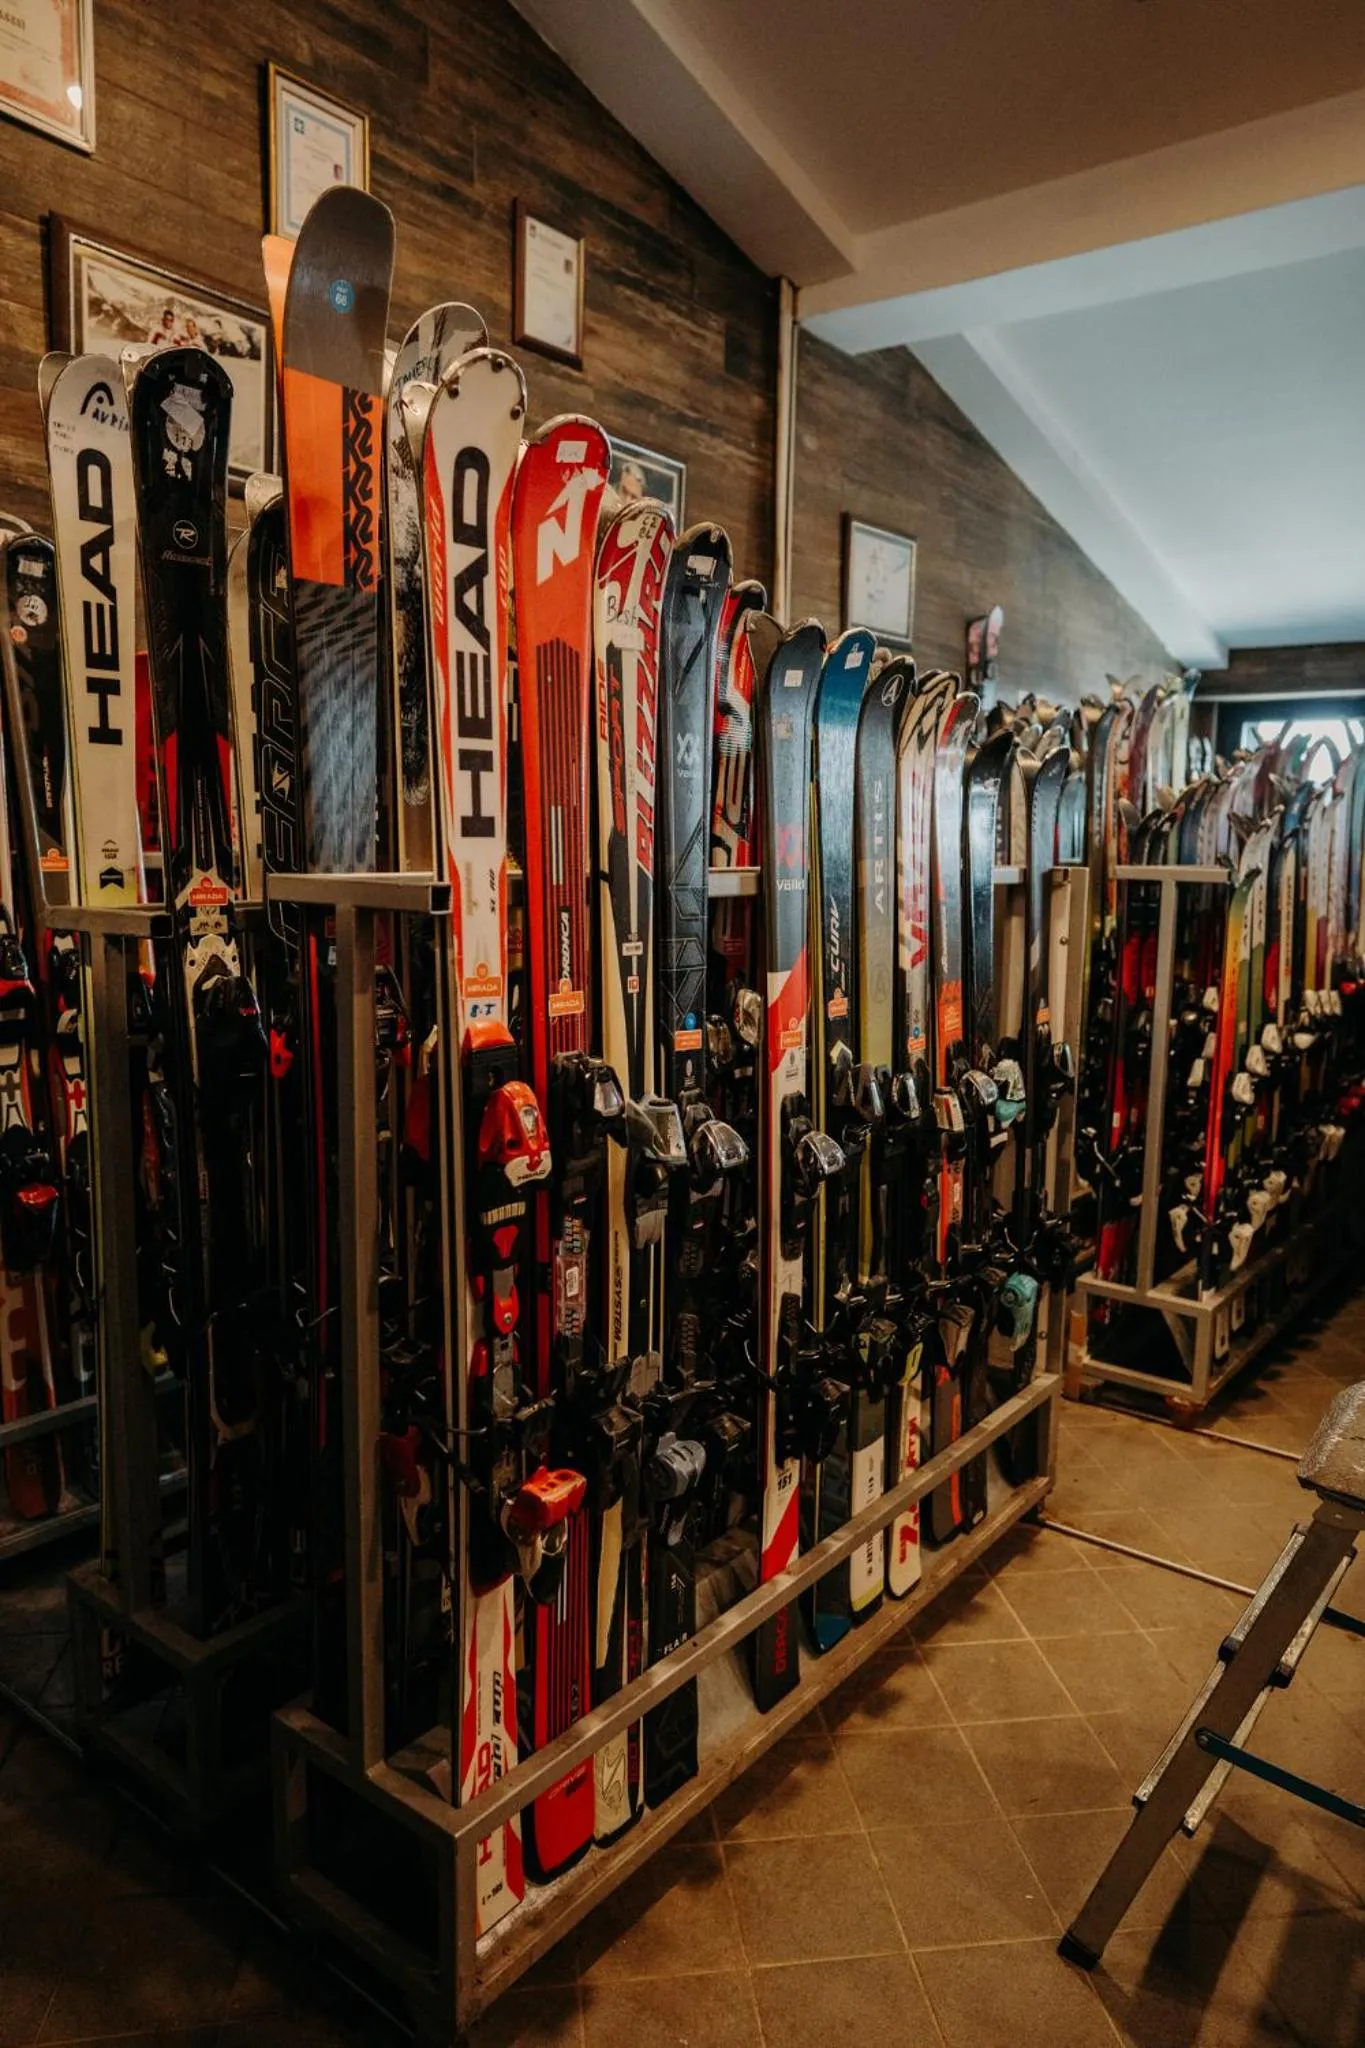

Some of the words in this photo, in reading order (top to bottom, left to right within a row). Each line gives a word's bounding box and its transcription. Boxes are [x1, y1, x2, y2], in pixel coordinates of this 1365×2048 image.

[76, 447, 123, 746] HEAD
[452, 446, 496, 838] HEAD
[609, 663, 626, 837] SPORT
[873, 778, 885, 915] ARTIS
